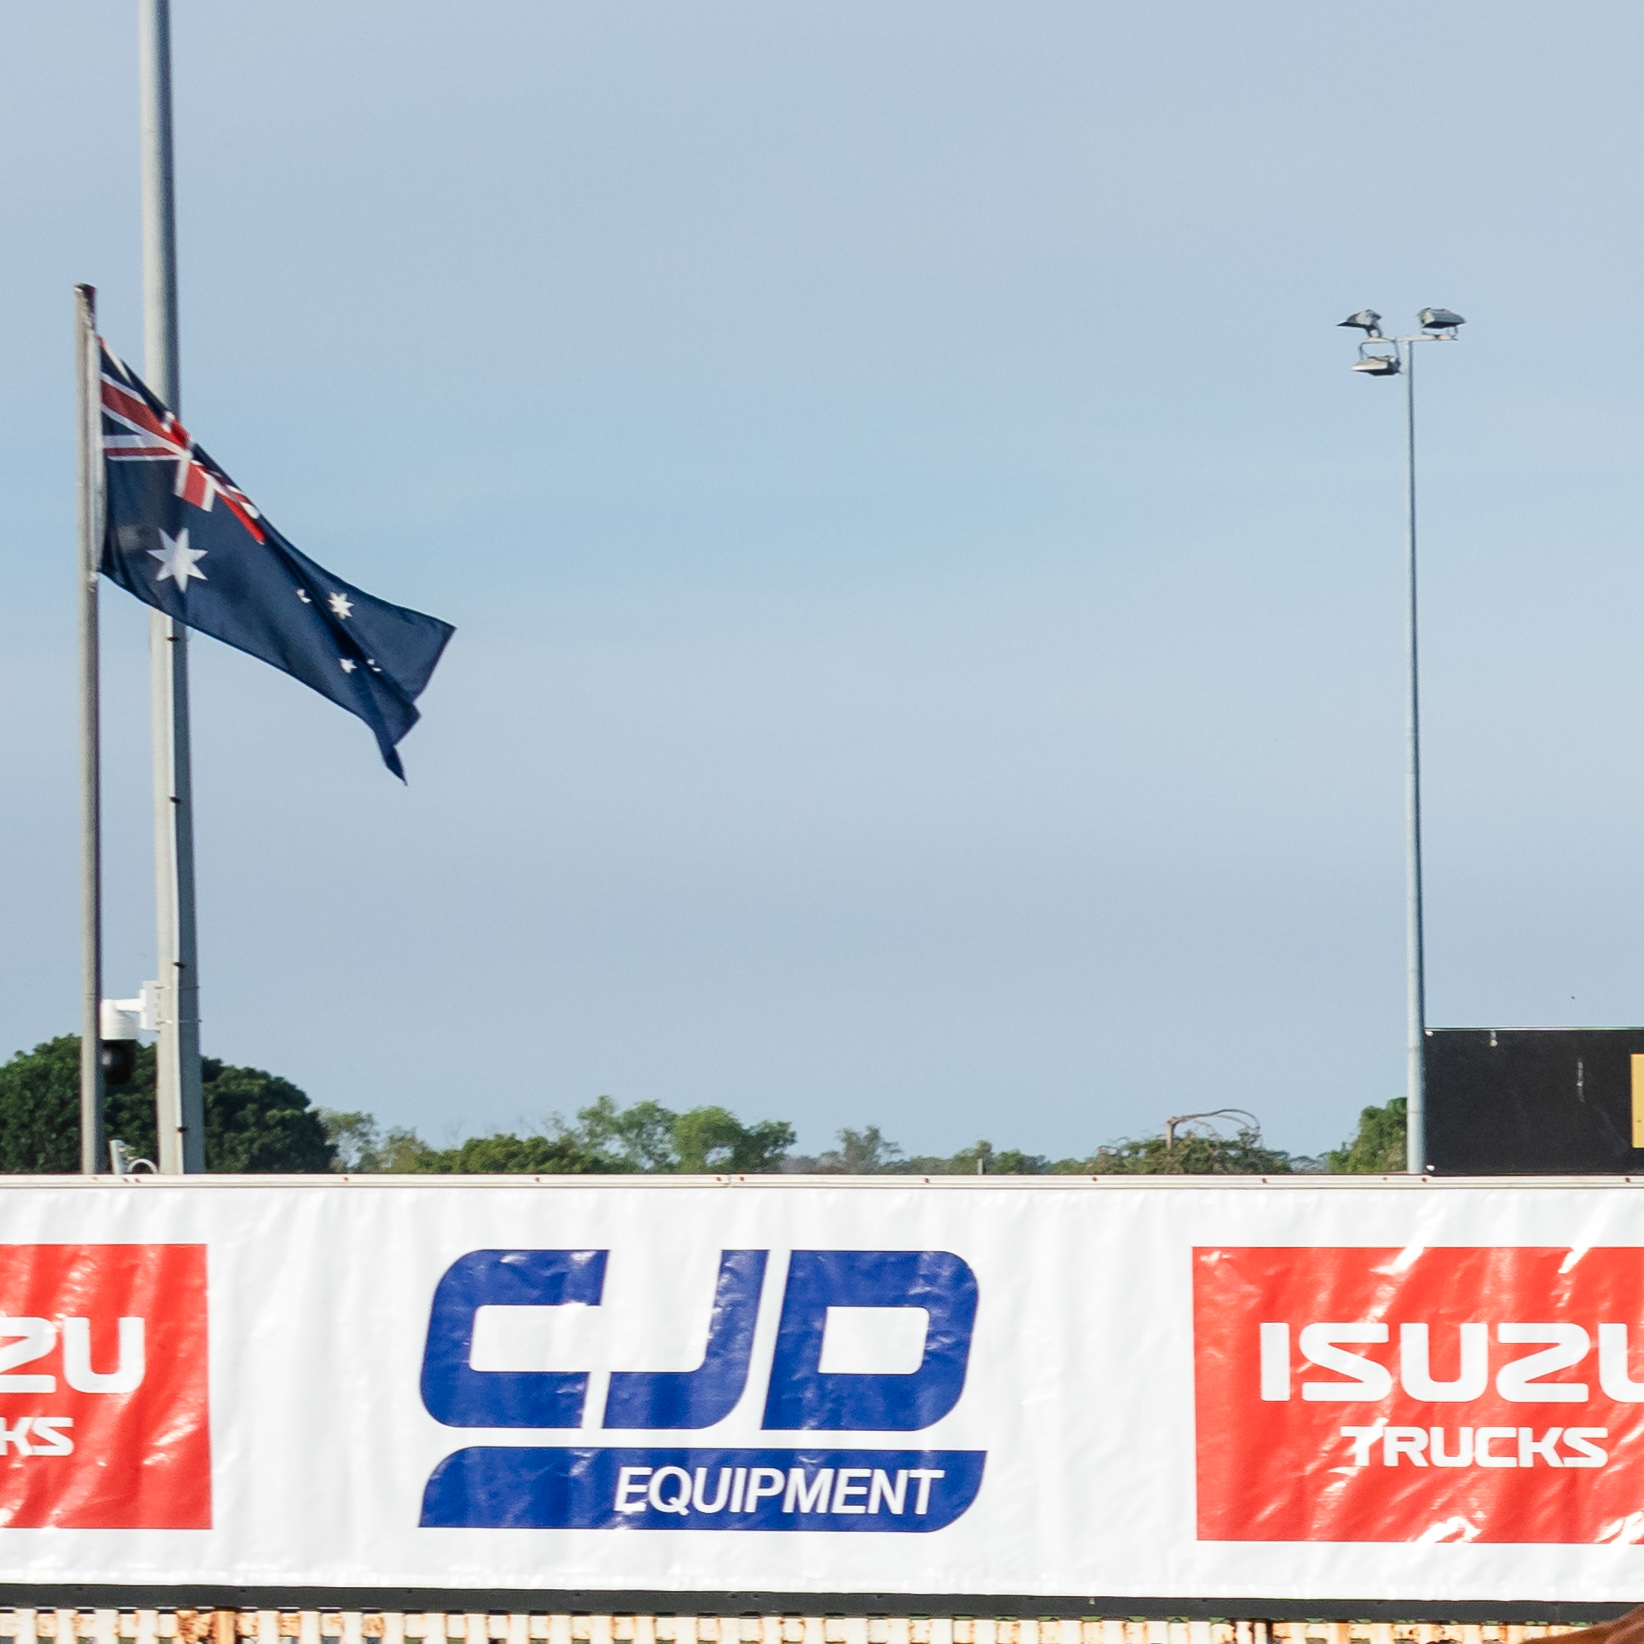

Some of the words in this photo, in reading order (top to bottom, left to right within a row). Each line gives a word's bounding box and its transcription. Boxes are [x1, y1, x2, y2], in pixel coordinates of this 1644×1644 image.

[420, 1249, 980, 1432] CJD
[1341, 1426, 1609, 1468] TRUCKS
[612, 1465, 945, 1516] EQUIPMENT
